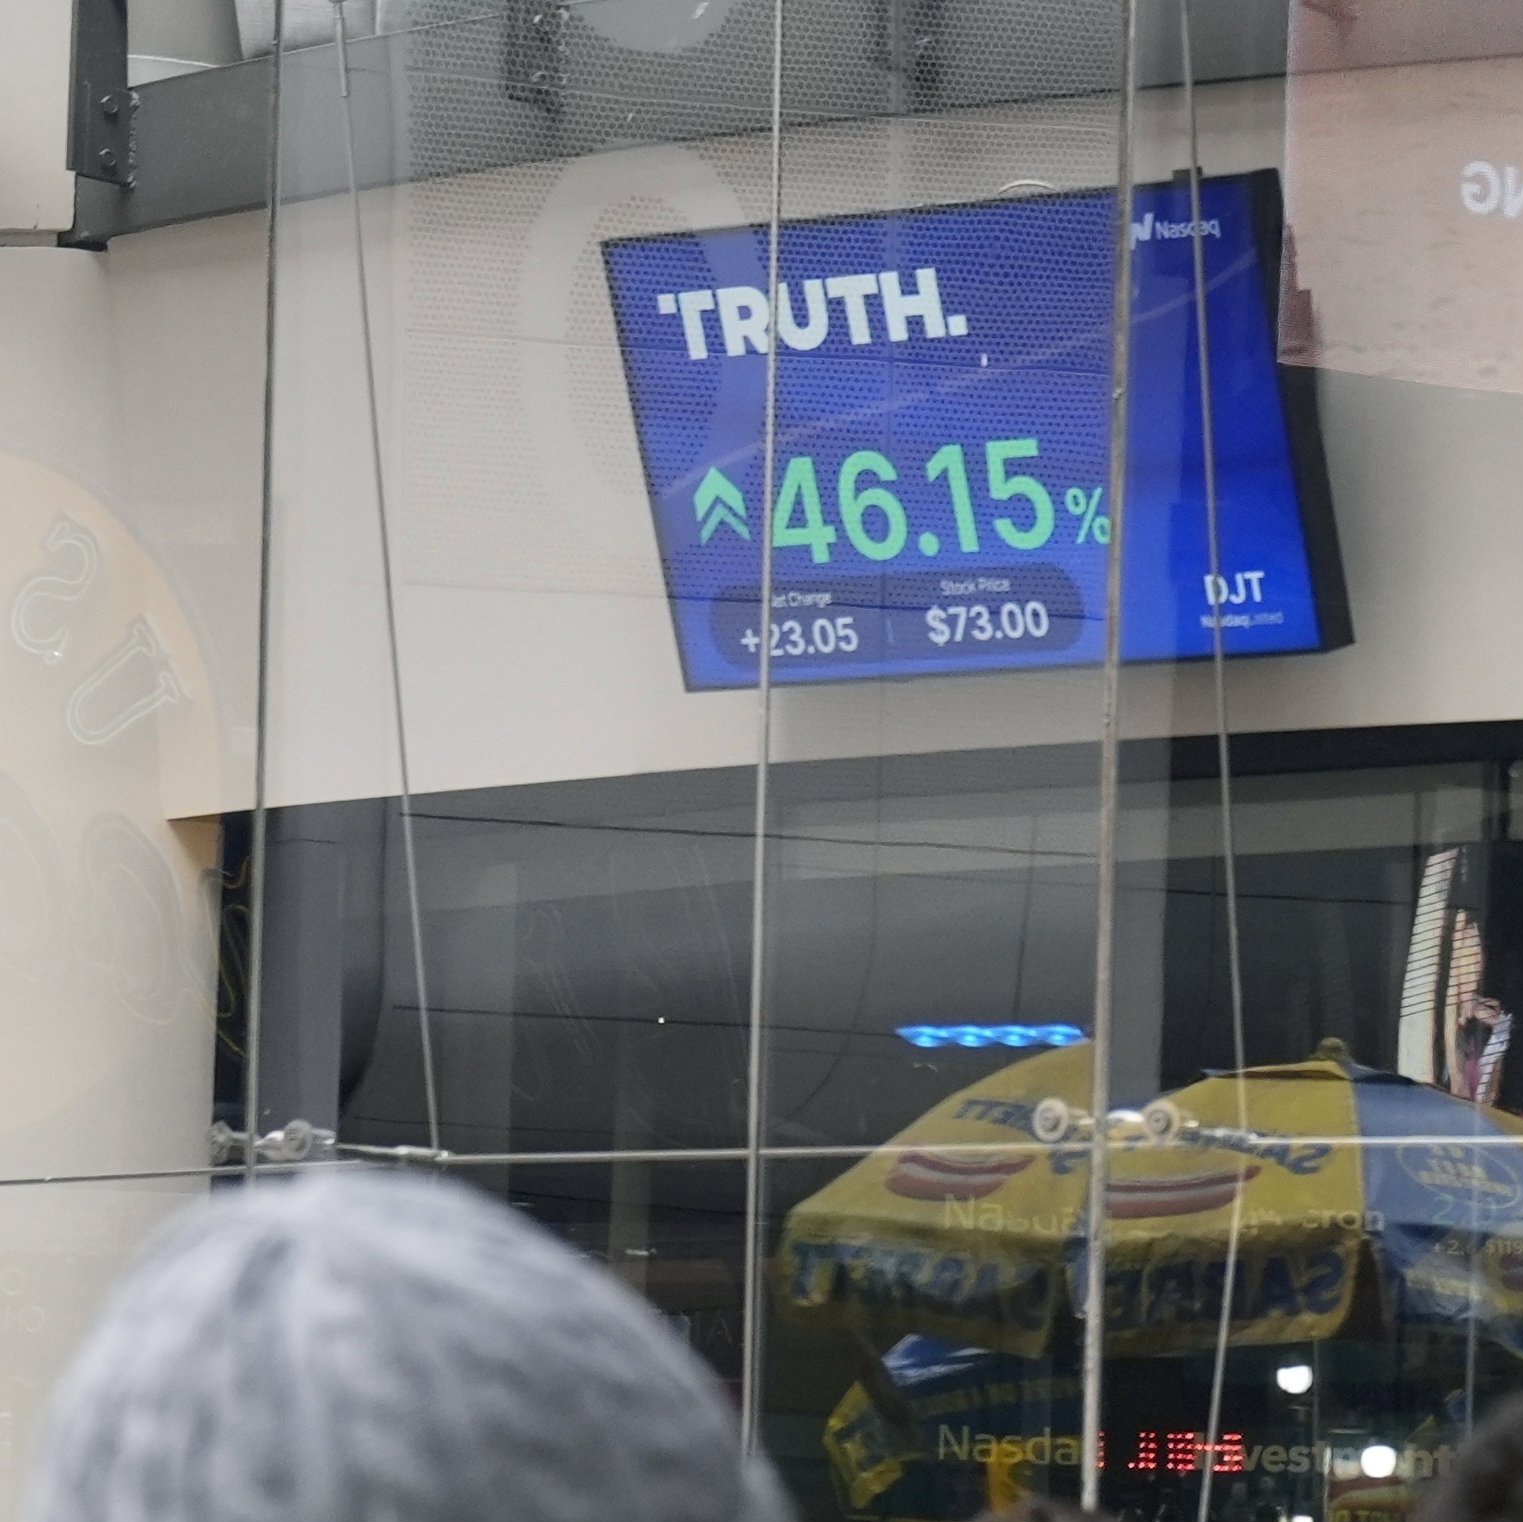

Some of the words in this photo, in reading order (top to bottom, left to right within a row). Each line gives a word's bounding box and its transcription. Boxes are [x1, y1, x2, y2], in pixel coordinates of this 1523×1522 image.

[658, 267, 968, 360] TRUTH.
[1203, 570, 1266, 605] DJT
[925, 600, 1050, 648] $73.00
[937, 1424, 1084, 1466] Nasda
